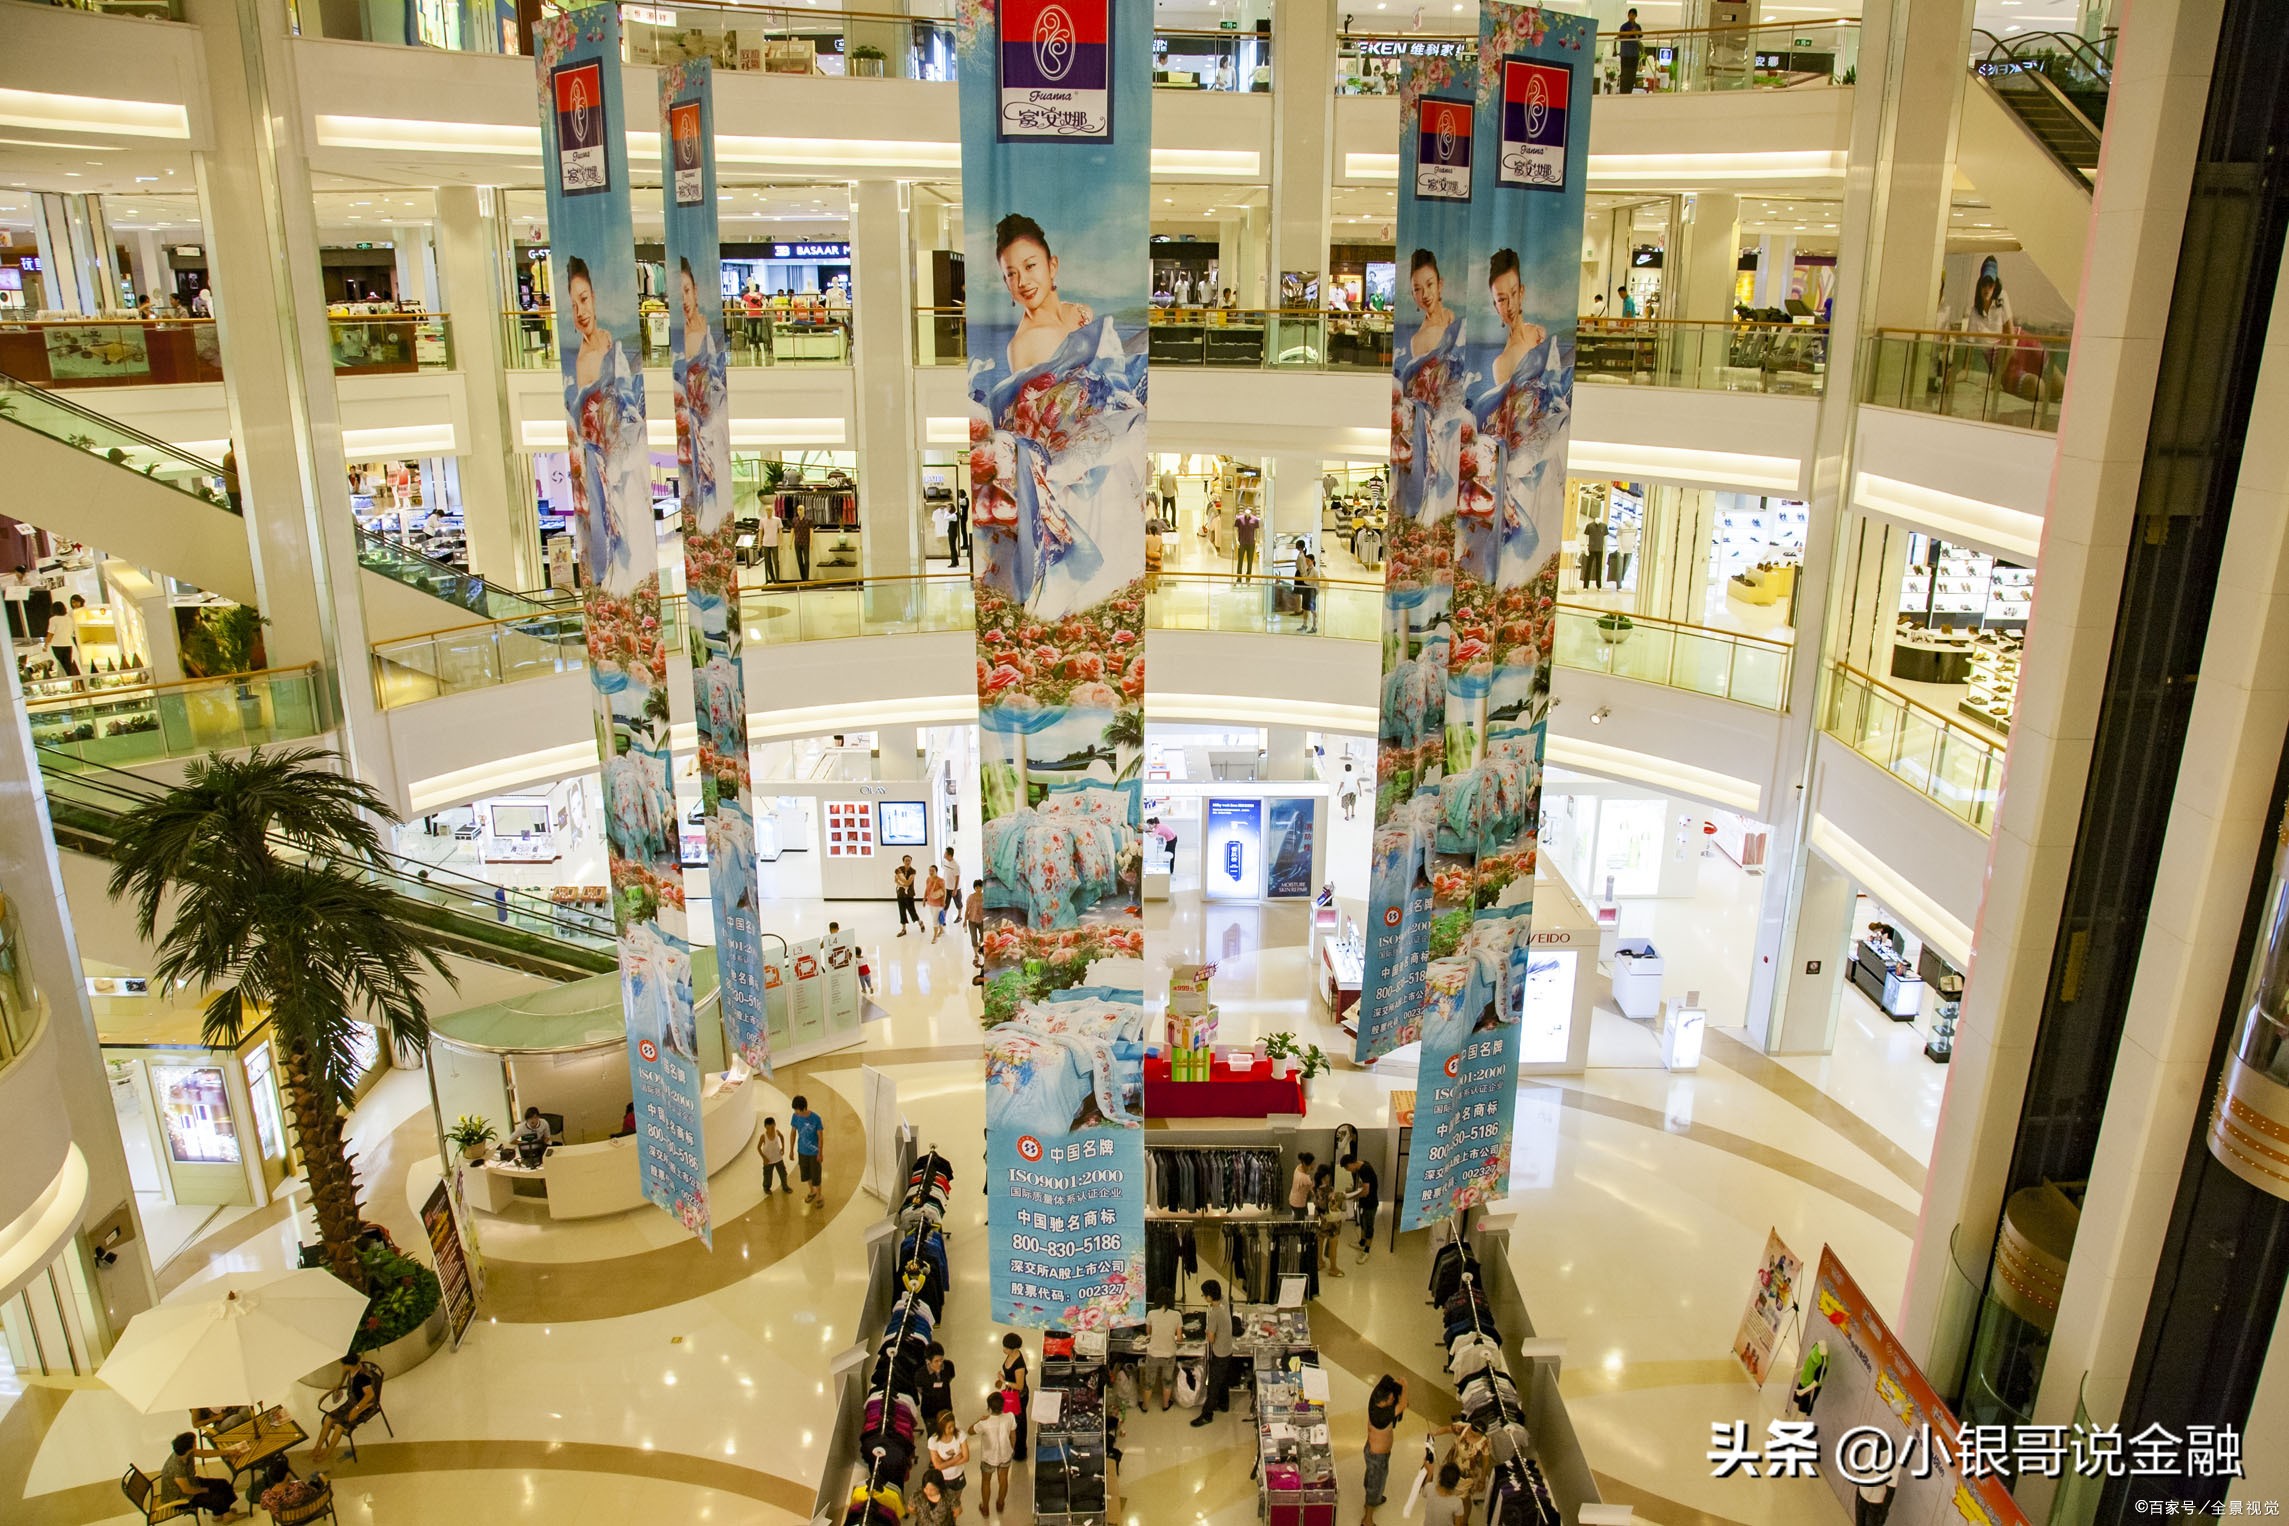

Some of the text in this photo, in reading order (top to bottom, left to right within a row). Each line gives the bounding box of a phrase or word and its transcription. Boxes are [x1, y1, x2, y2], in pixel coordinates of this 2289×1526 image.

[1029, 90, 1072, 102] Fuanna
[1004, 105, 1102, 132] 富安娜
[797, 245, 839, 255] BASAAR
[727, 917, 755, 936] 中国名
[828, 937, 838, 946] L4
[661, 1056, 687, 1085] 国名牌
[1050, 1138, 1114, 1165] 中国名牌
[1008, 1168, 1124, 1190] ISO9001:2000
[1010, 1187, 1122, 1206] 国际质量体系认证企业
[1017, 1208, 1117, 1233] 中国驰名商标
[1012, 1234, 1121, 1258] 800-830-5186
[1010, 1259, 1125, 1280] 深交所A股上市公司
